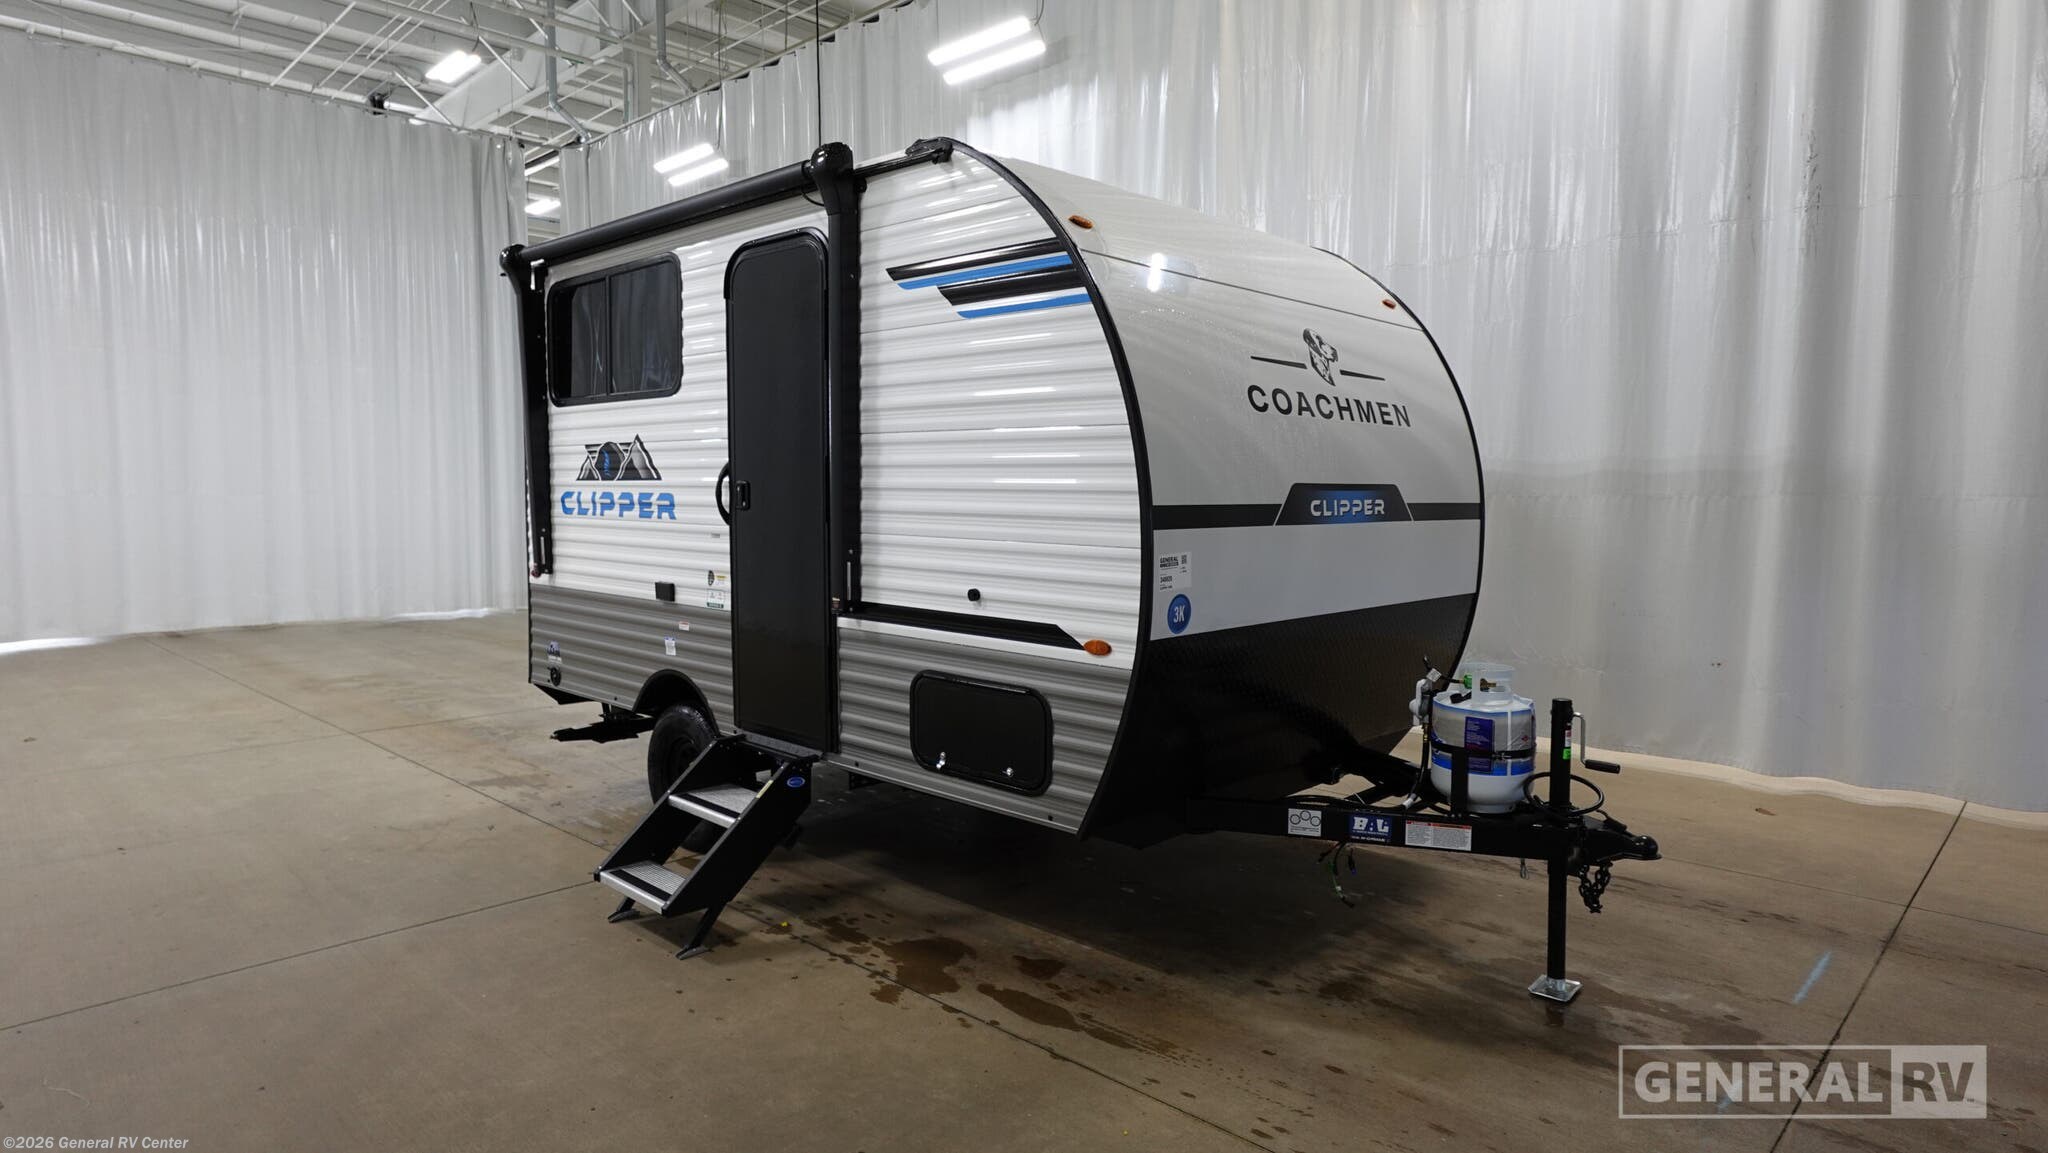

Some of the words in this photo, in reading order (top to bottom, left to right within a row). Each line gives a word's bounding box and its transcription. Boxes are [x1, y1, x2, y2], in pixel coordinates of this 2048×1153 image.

[1247, 384, 1412, 428] COACHMEN
[560, 491, 676, 520] CLIPPER
[1310, 499, 1385, 517] CLIPPER
[1173, 606, 1186, 623] 3K
